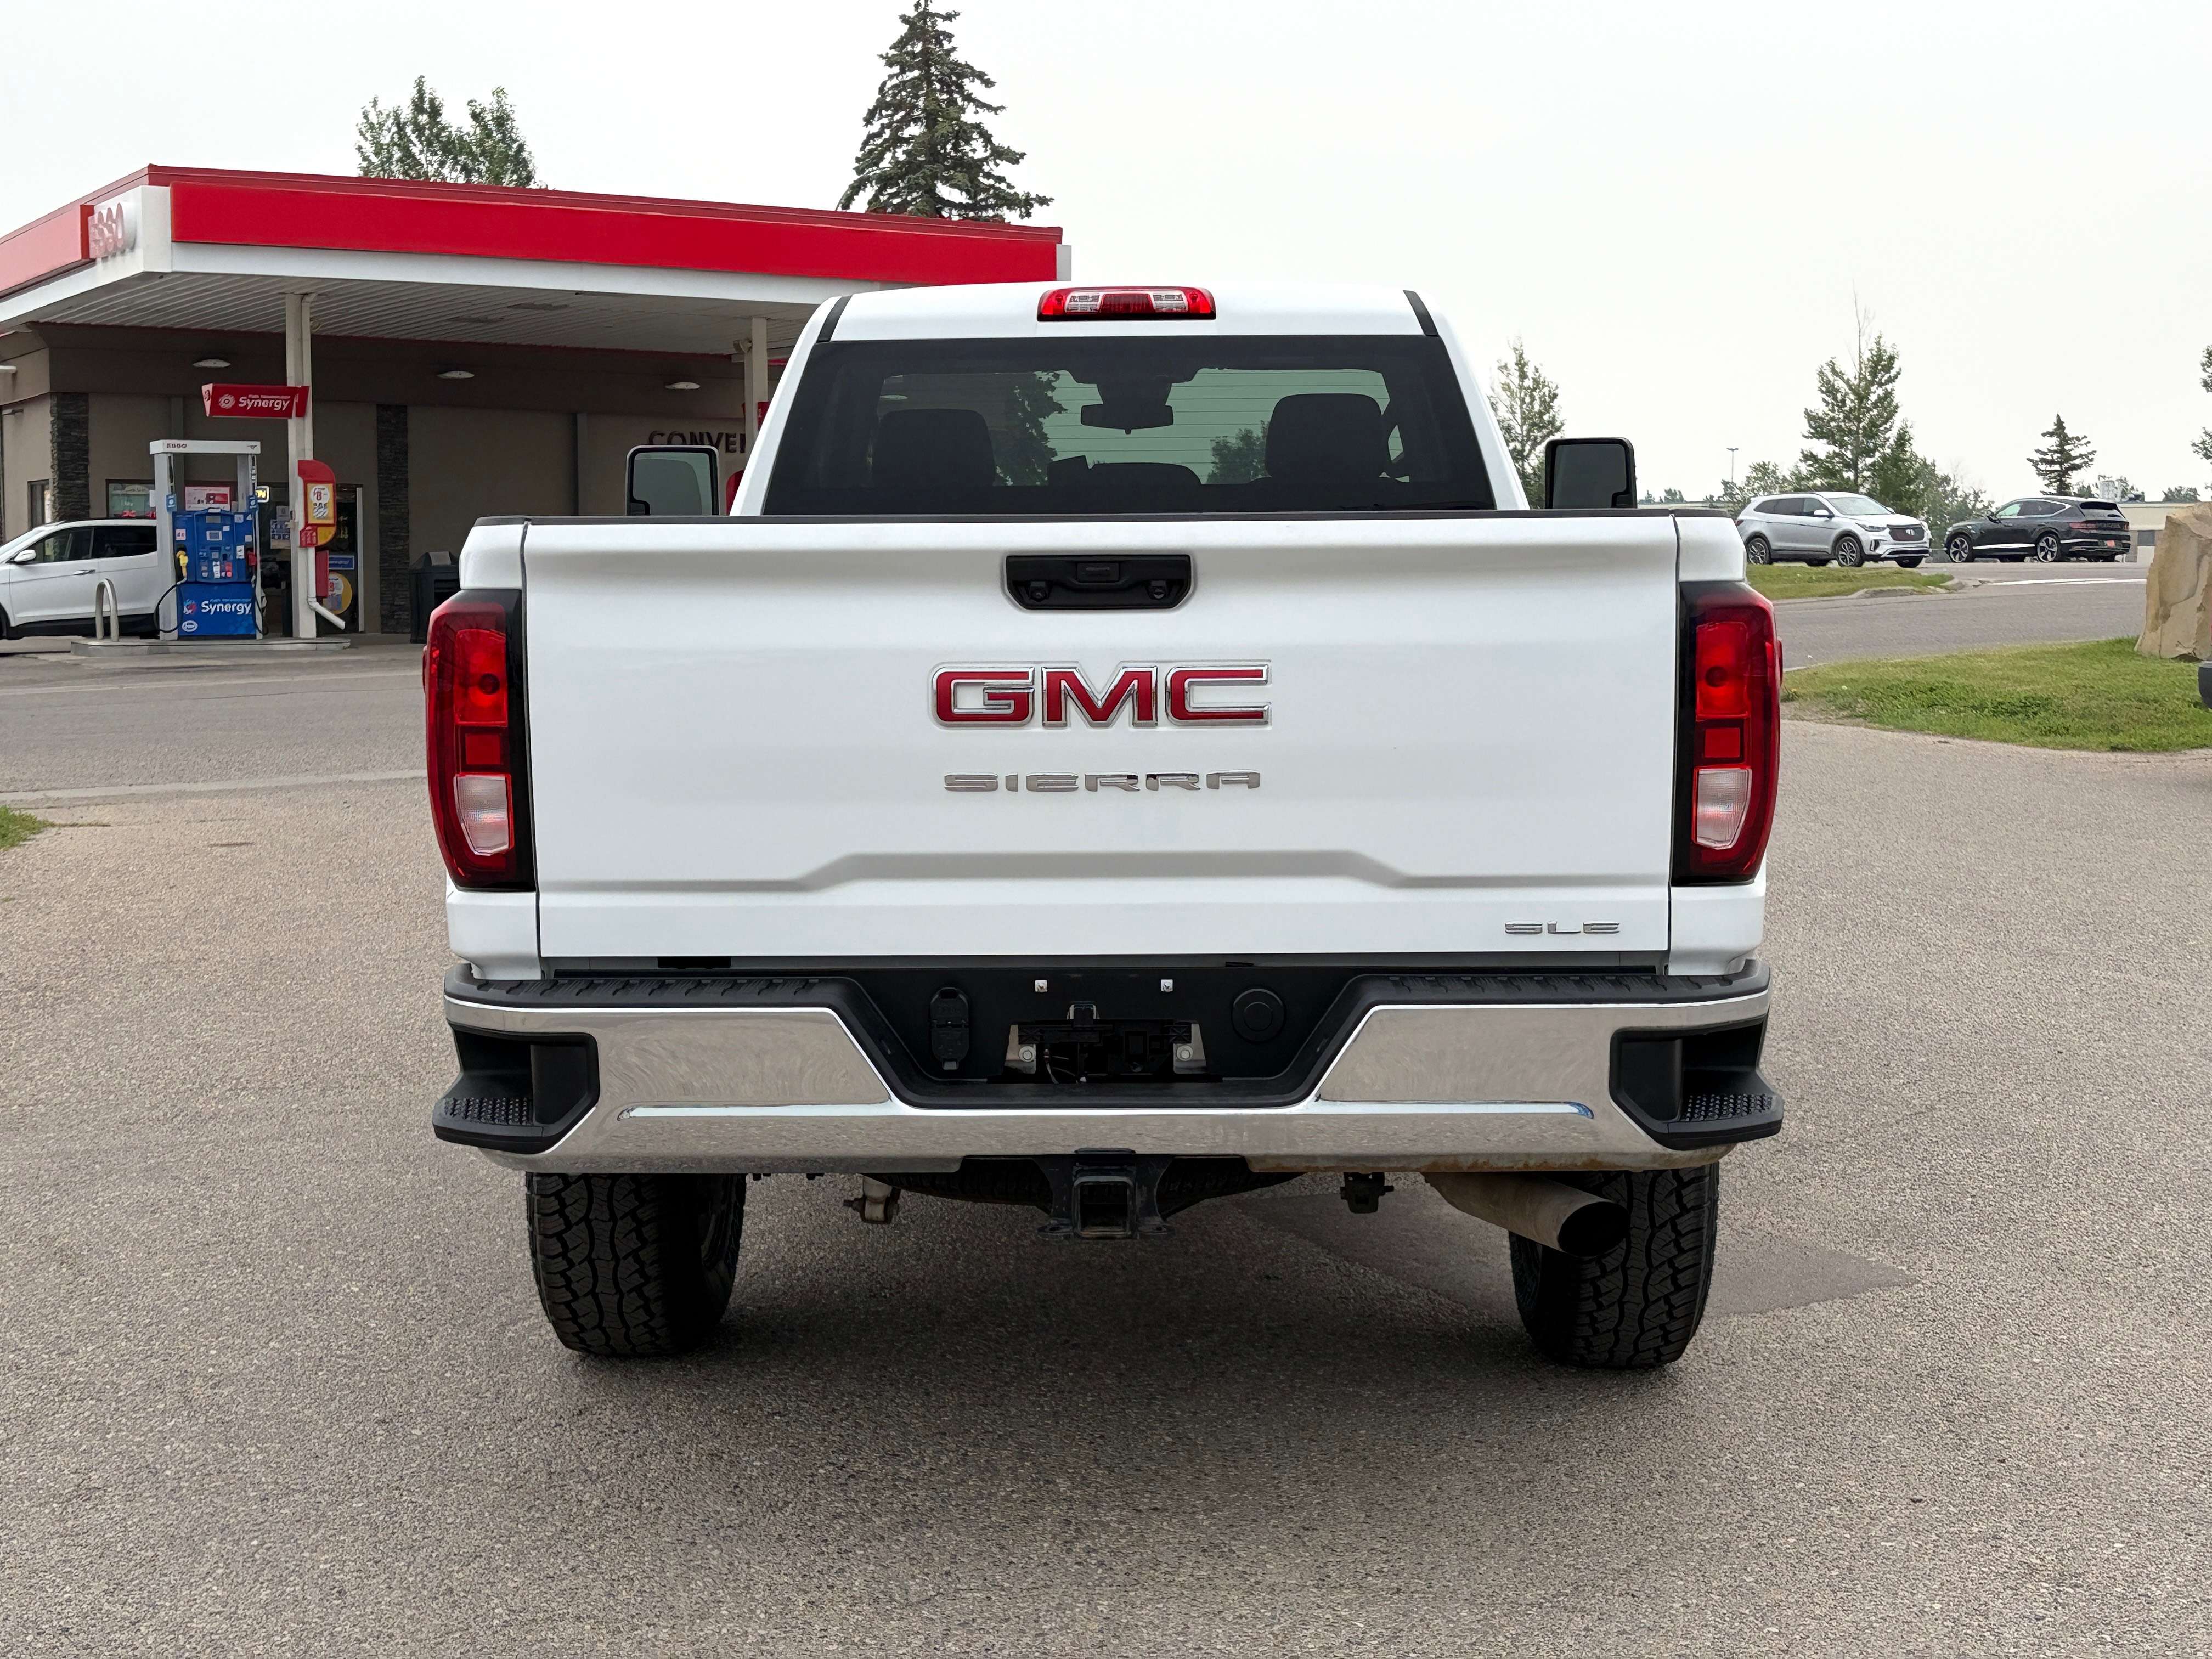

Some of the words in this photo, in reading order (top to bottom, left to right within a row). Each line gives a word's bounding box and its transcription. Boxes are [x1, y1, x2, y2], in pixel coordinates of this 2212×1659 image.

[239, 396, 290, 411] Synergy
[201, 601, 252, 615] Synergy
[931, 663, 1271, 728] GMC
[944, 770, 1261, 792] SIERRA
[1505, 921, 1620, 935] SLE
